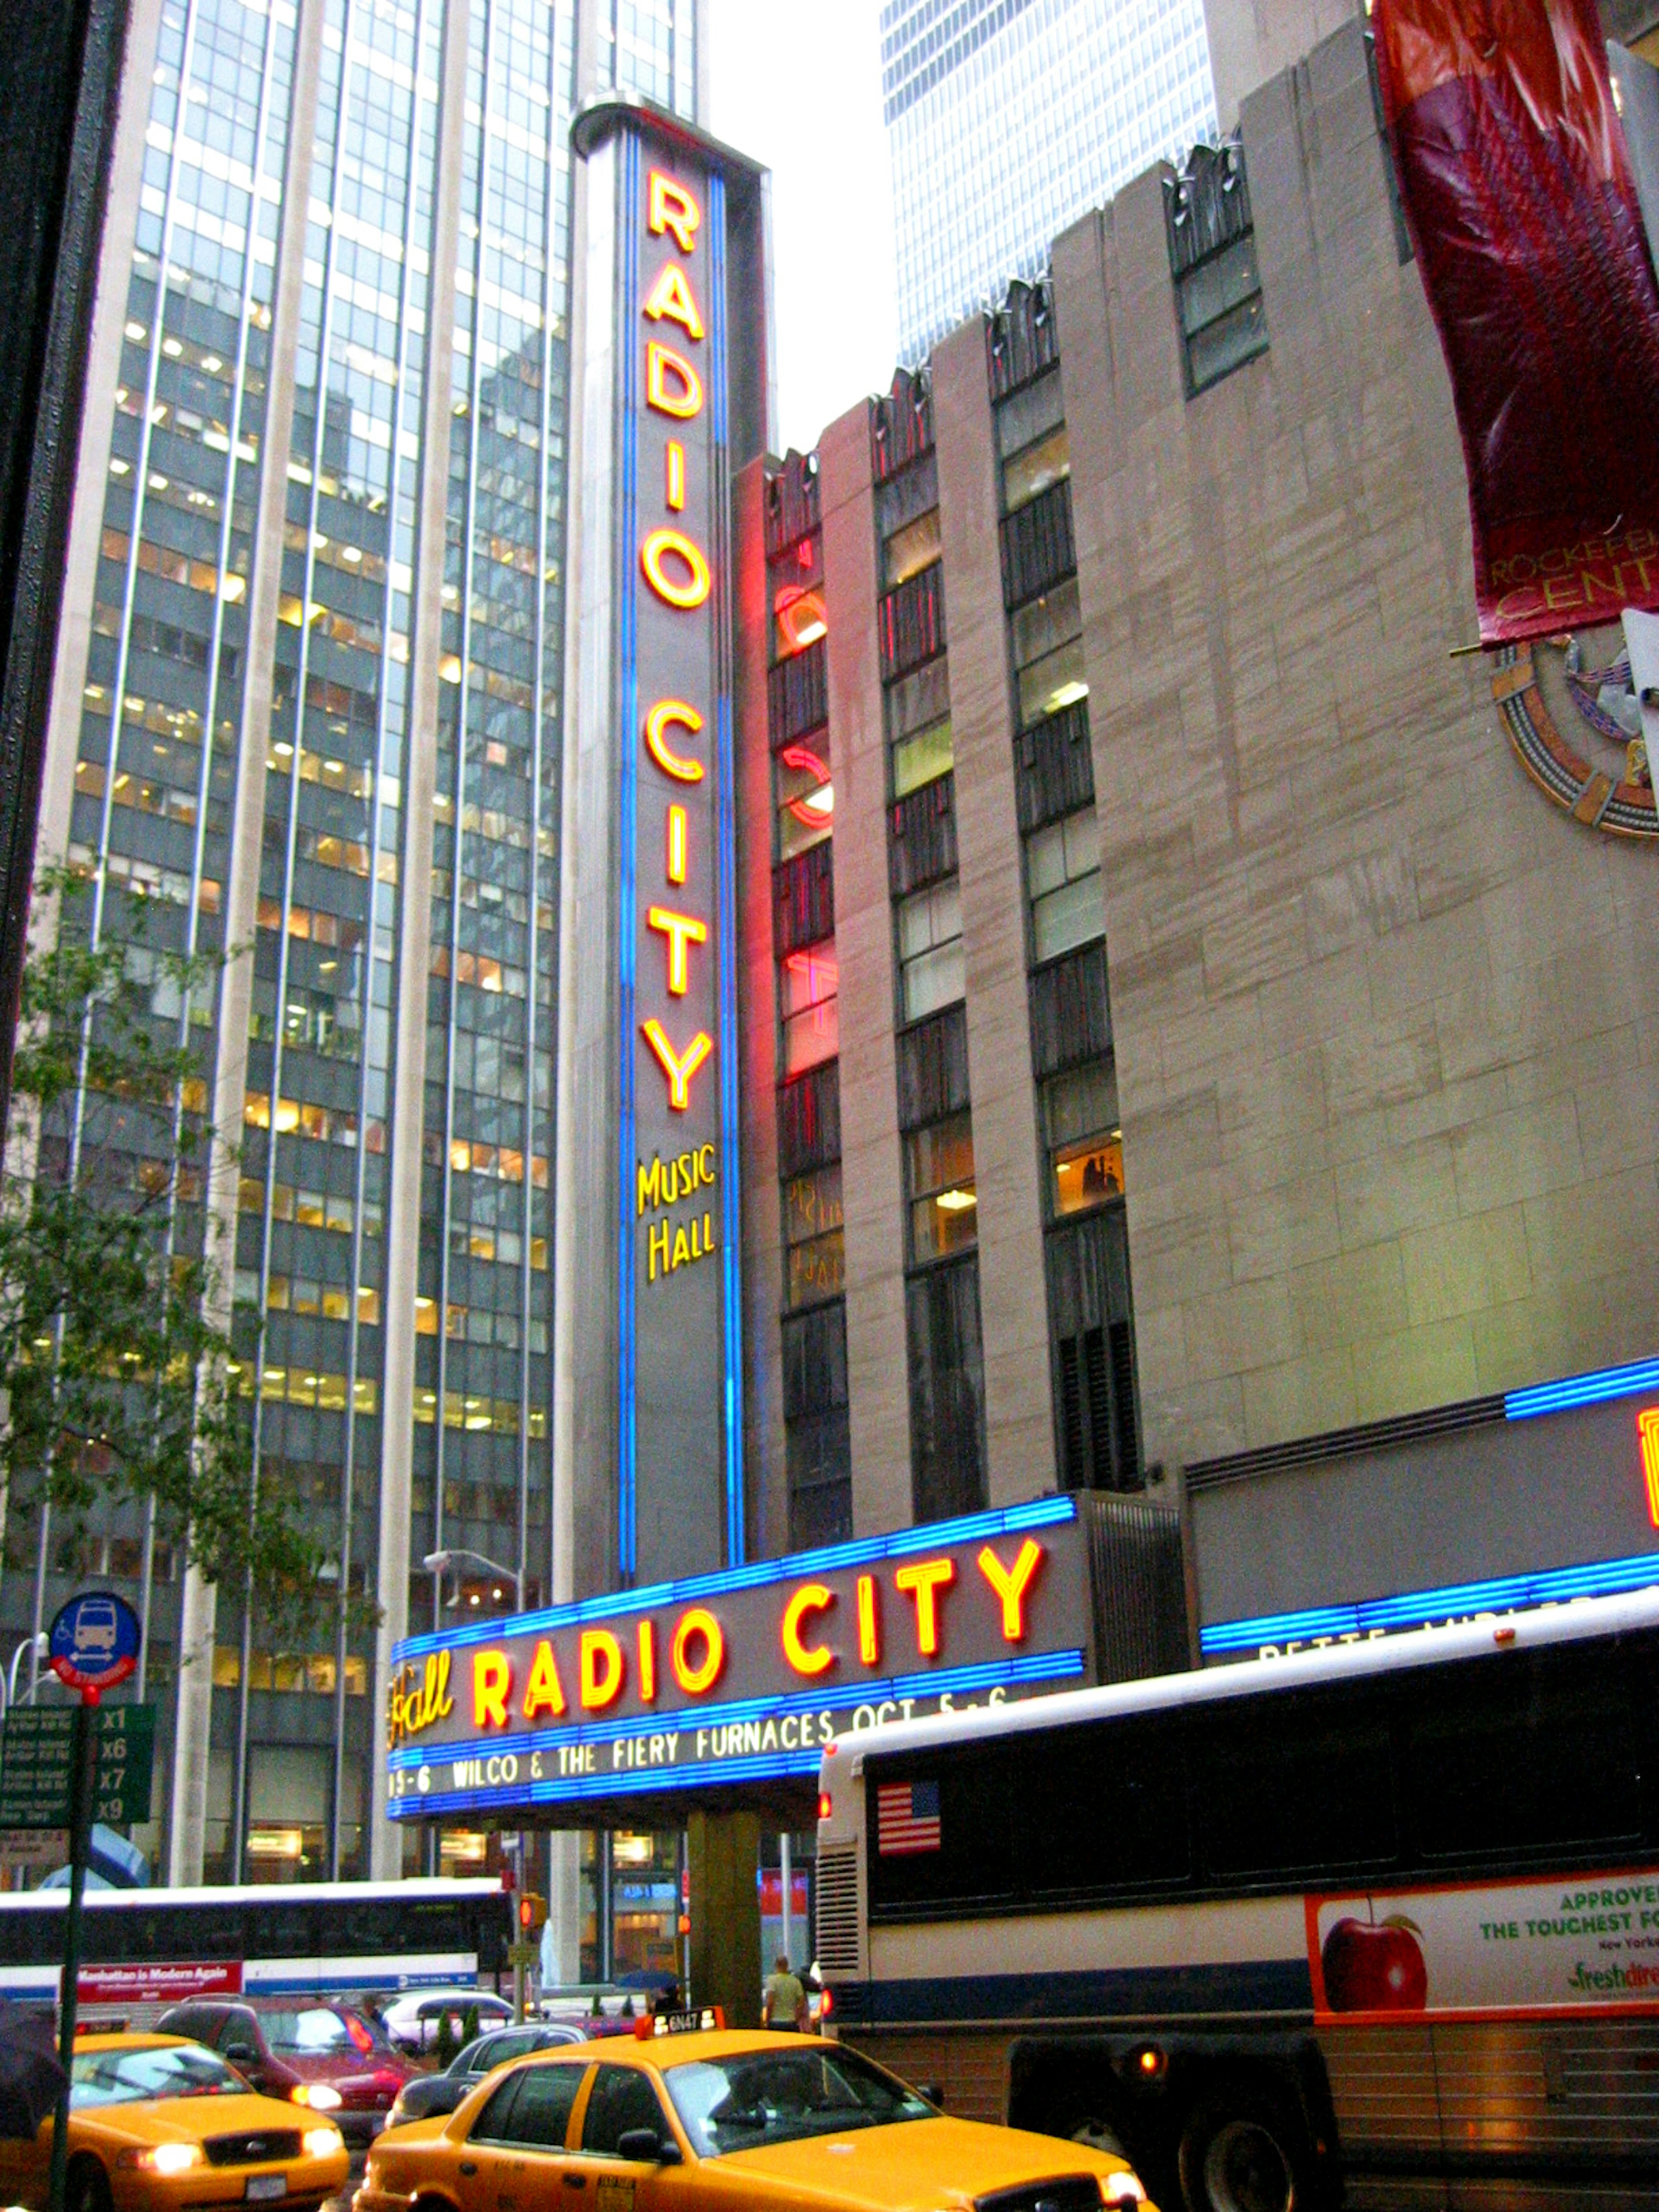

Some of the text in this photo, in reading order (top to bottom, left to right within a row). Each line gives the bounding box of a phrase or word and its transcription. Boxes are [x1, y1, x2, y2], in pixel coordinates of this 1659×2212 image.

[645, 168, 712, 1110] RADIO CITY
[638, 1143, 715, 1216] MUSIC
[649, 1212, 715, 1281] HALL
[473, 1607, 724, 1728] RADIO
[781, 1537, 1041, 1677] CITY
[453, 1754, 518, 1787] WILCO
[530, 1751, 543, 1778] &
[558, 1743, 596, 1775] THE
[613, 1731, 679, 1769] FIERY
[696, 1710, 834, 1759] FURNACES
[1481, 1922, 1519, 1939] THE
[1526, 1912, 1632, 1937] TOUCHEST
[1561, 1886, 1659, 1910] APPROVE
[78, 1966, 227, 1981] Manhattan is Modern Again
